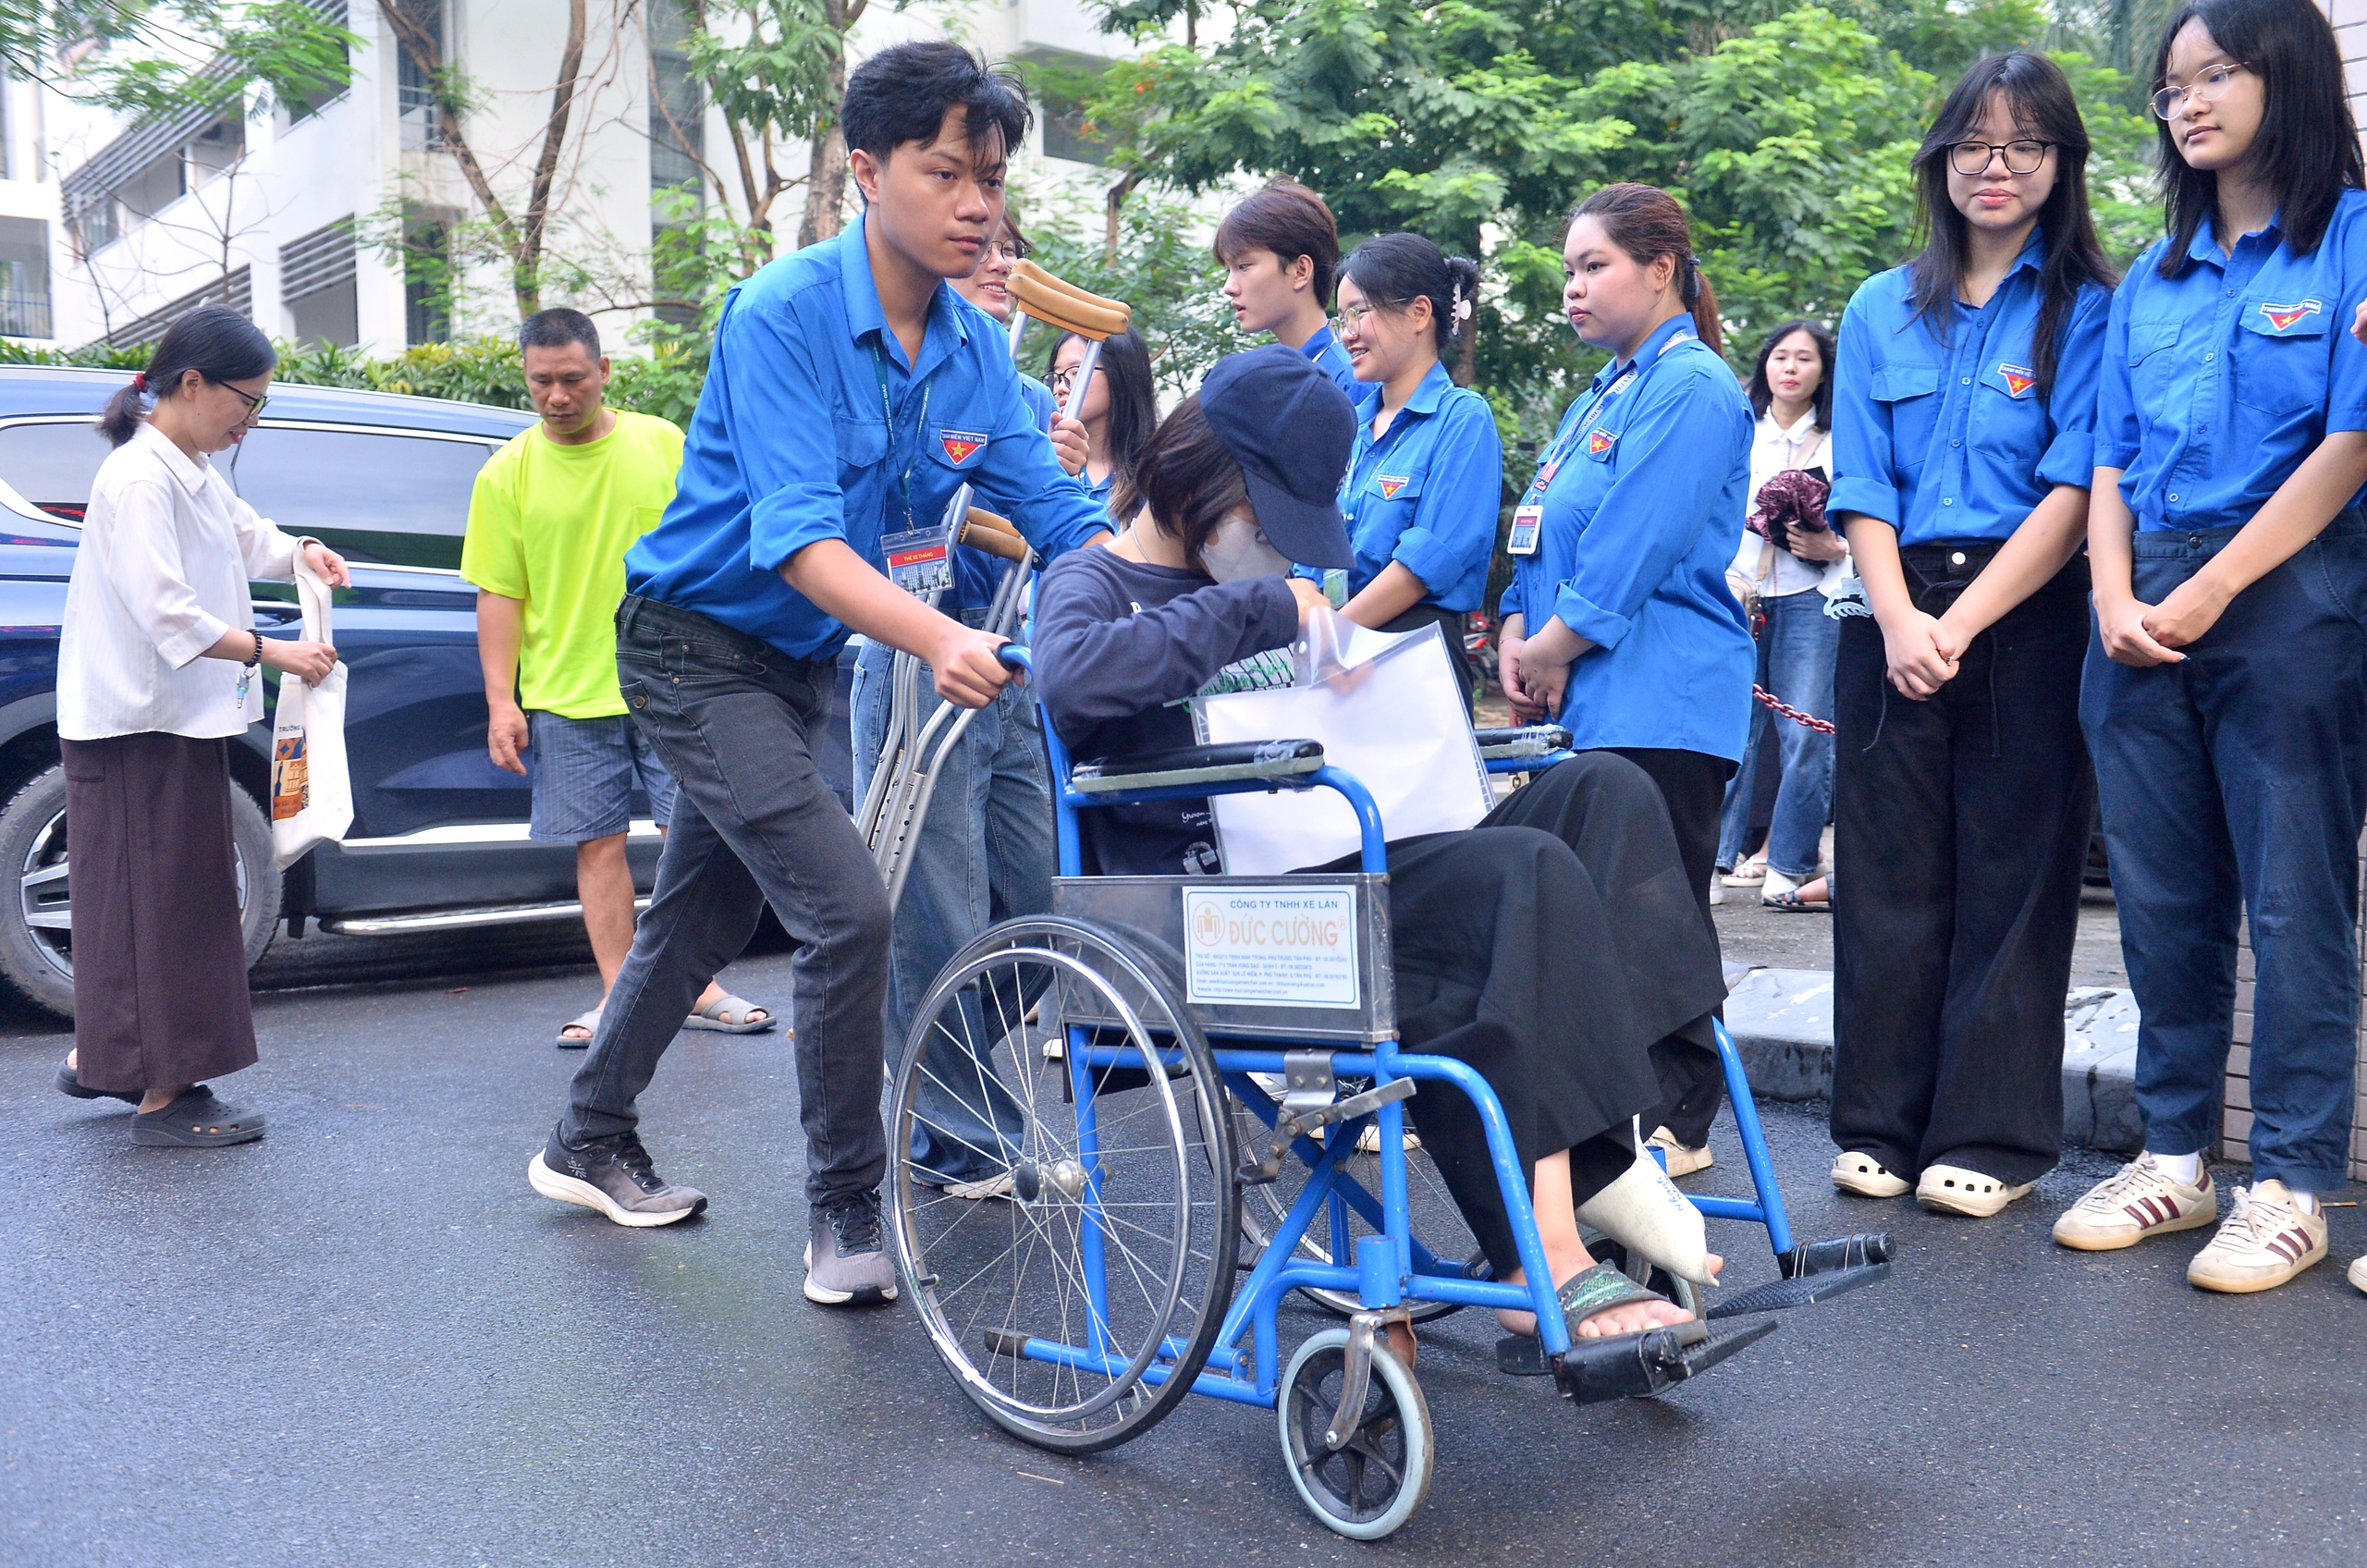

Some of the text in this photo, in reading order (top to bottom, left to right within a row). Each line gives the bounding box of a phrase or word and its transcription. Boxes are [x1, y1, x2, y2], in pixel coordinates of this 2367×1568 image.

[1230, 899, 1257, 909] CÔNG
[1259, 900, 1271, 909] TY
[1274, 900, 1300, 909] TNHH
[1303, 900, 1316, 909] XE
[1229, 913, 1339, 947] ĐỨC CƯỜNG
